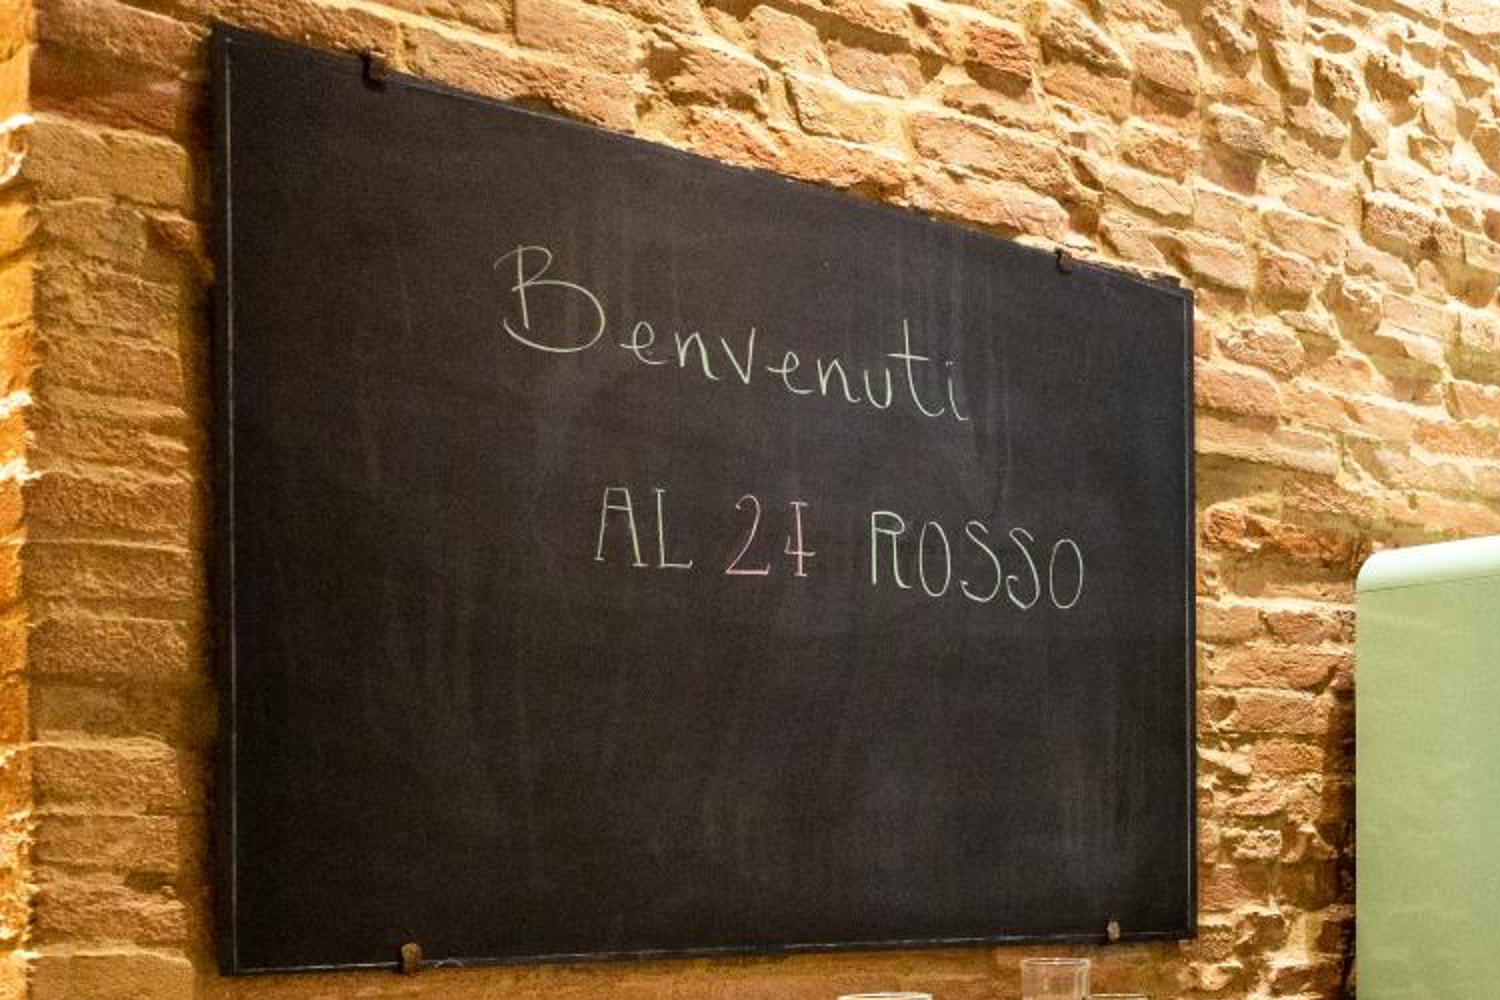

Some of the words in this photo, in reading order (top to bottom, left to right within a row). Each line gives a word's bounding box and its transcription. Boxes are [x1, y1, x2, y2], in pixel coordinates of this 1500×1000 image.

[493, 244, 970, 423] Benvenuti
[593, 487, 694, 570] AL
[725, 493, 817, 578] 24
[870, 509, 1085, 611] ROSSO
